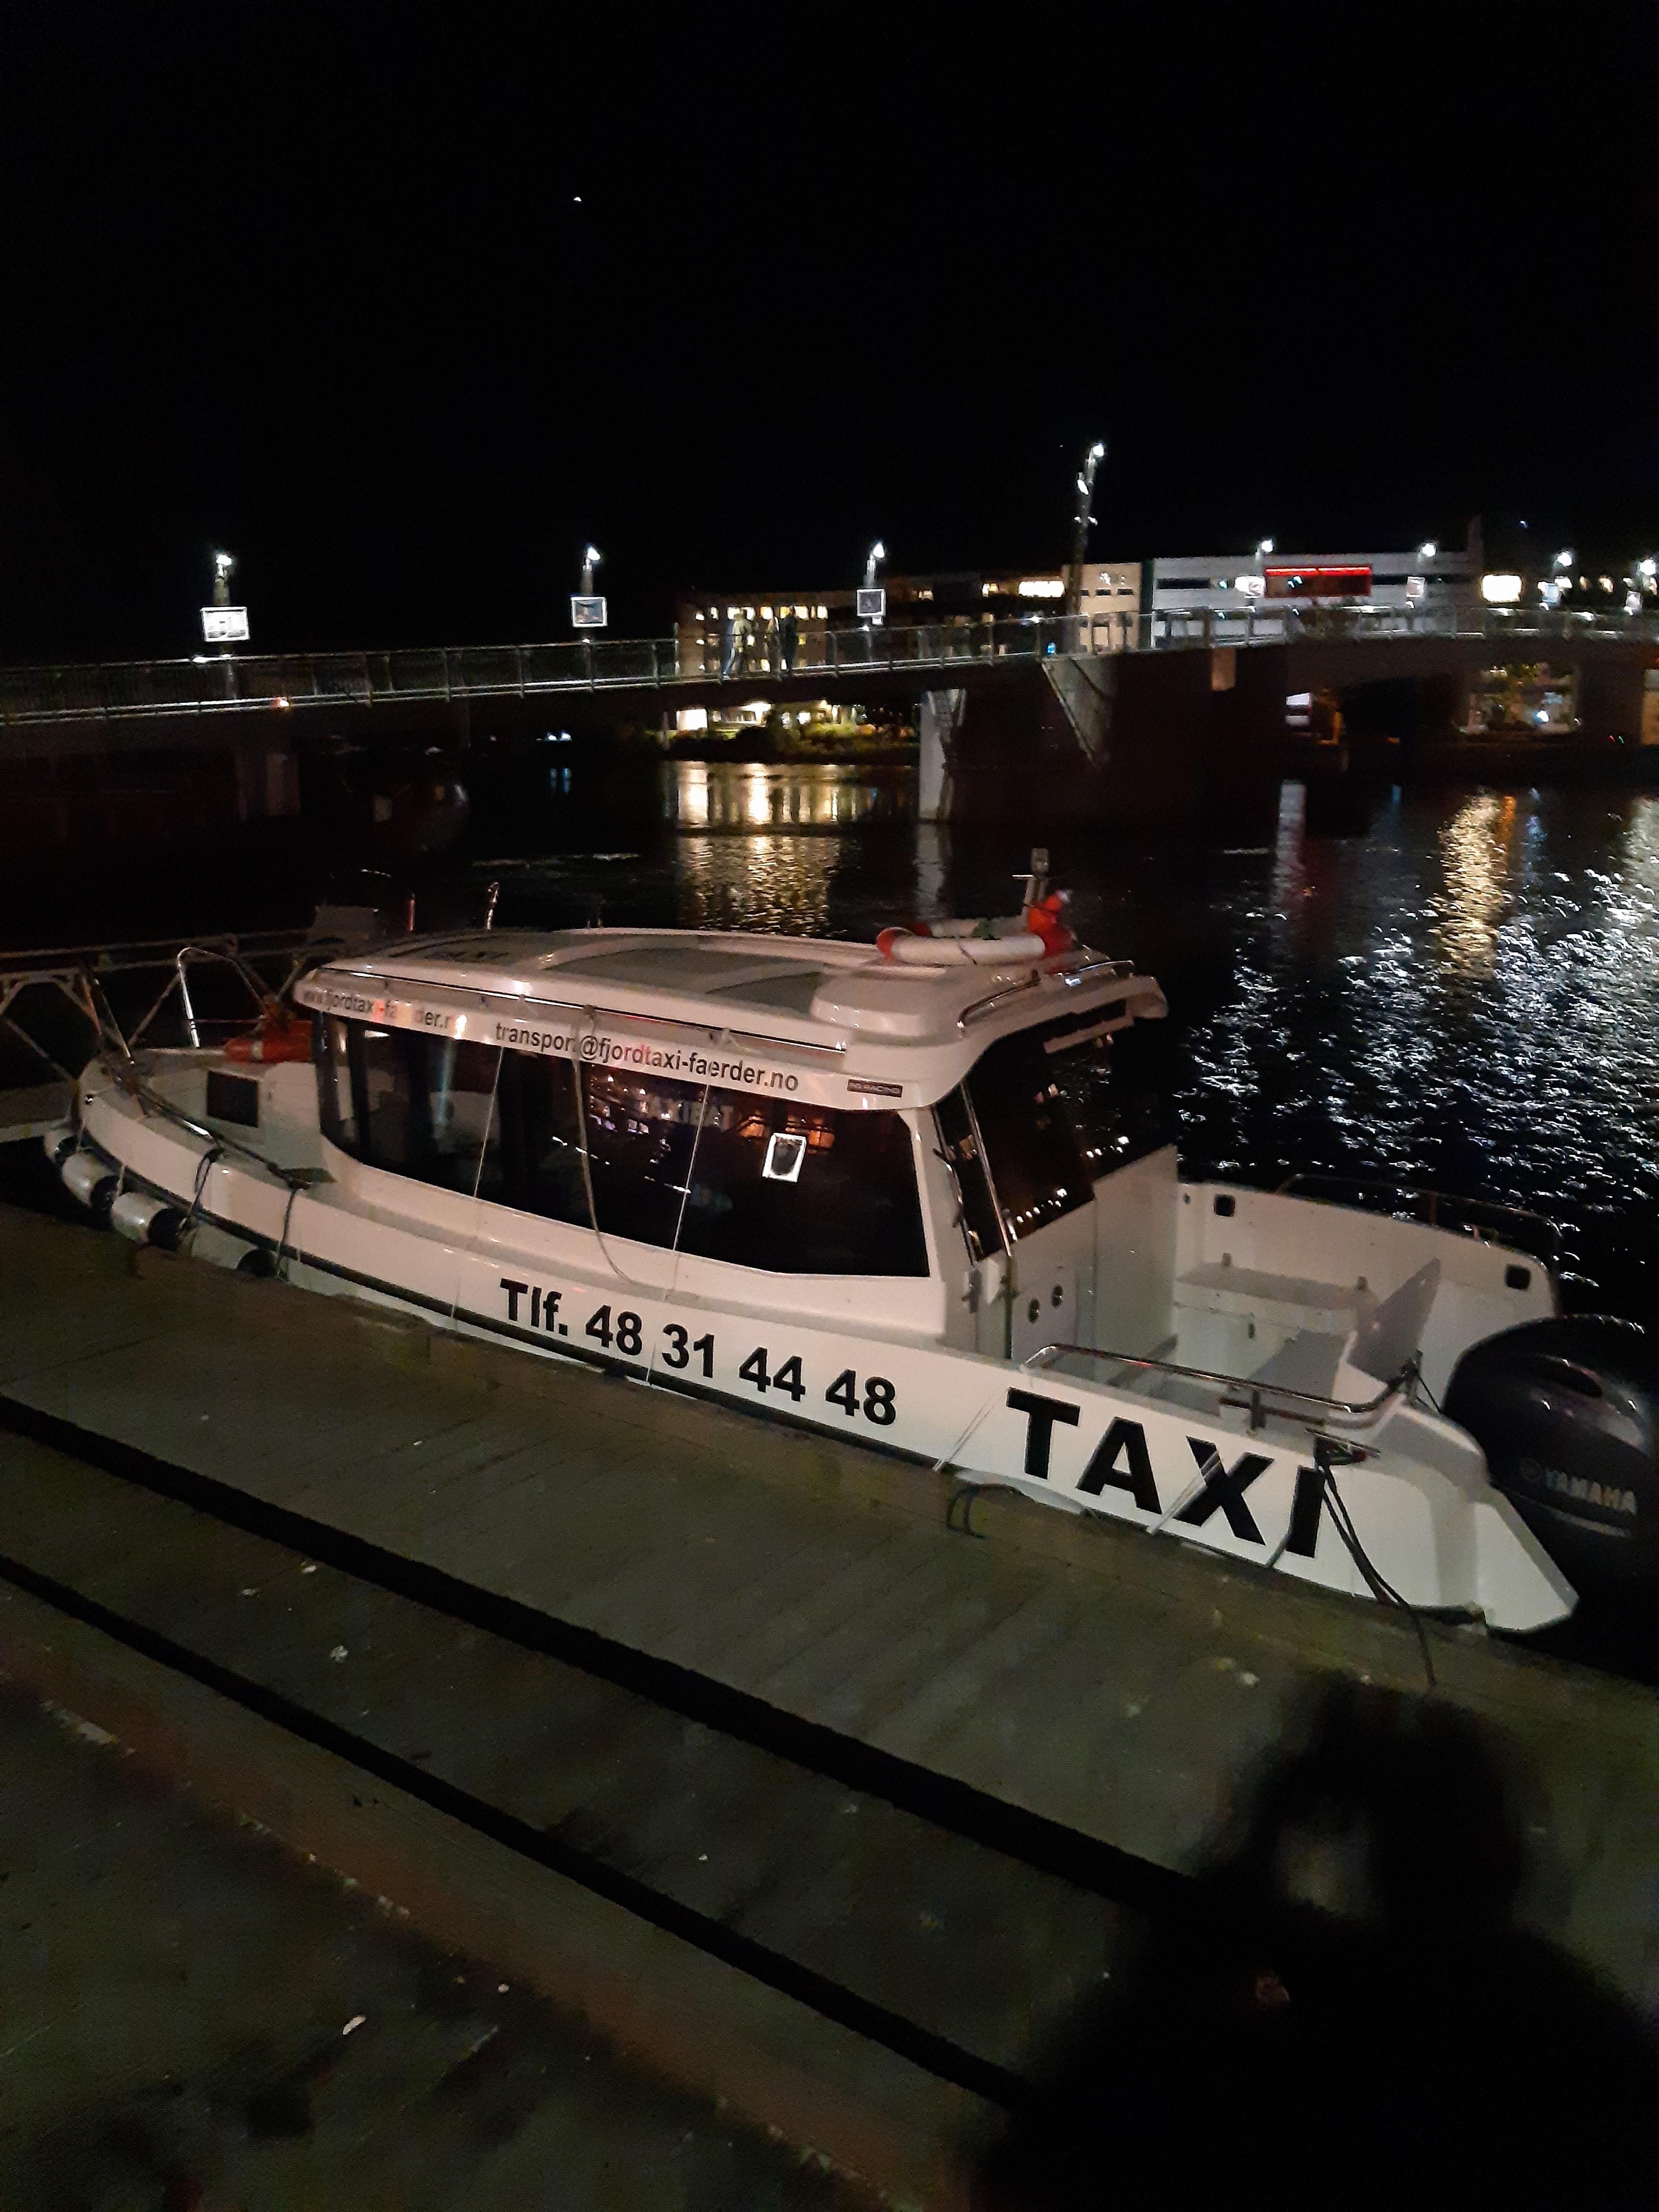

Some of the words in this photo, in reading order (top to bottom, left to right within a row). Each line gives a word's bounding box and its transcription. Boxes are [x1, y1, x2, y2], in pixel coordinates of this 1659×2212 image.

[496, 1022, 799, 1091] transpor@fjordtaxi-faerder.no
[500, 1277, 568, 1336] Tlf.
[585, 1305, 642, 1356] 48
[662, 1323, 714, 1379] 31
[739, 1347, 805, 1402] 44
[825, 1369, 897, 1426] 48
[1006, 1386, 1325, 1558] TAXI
